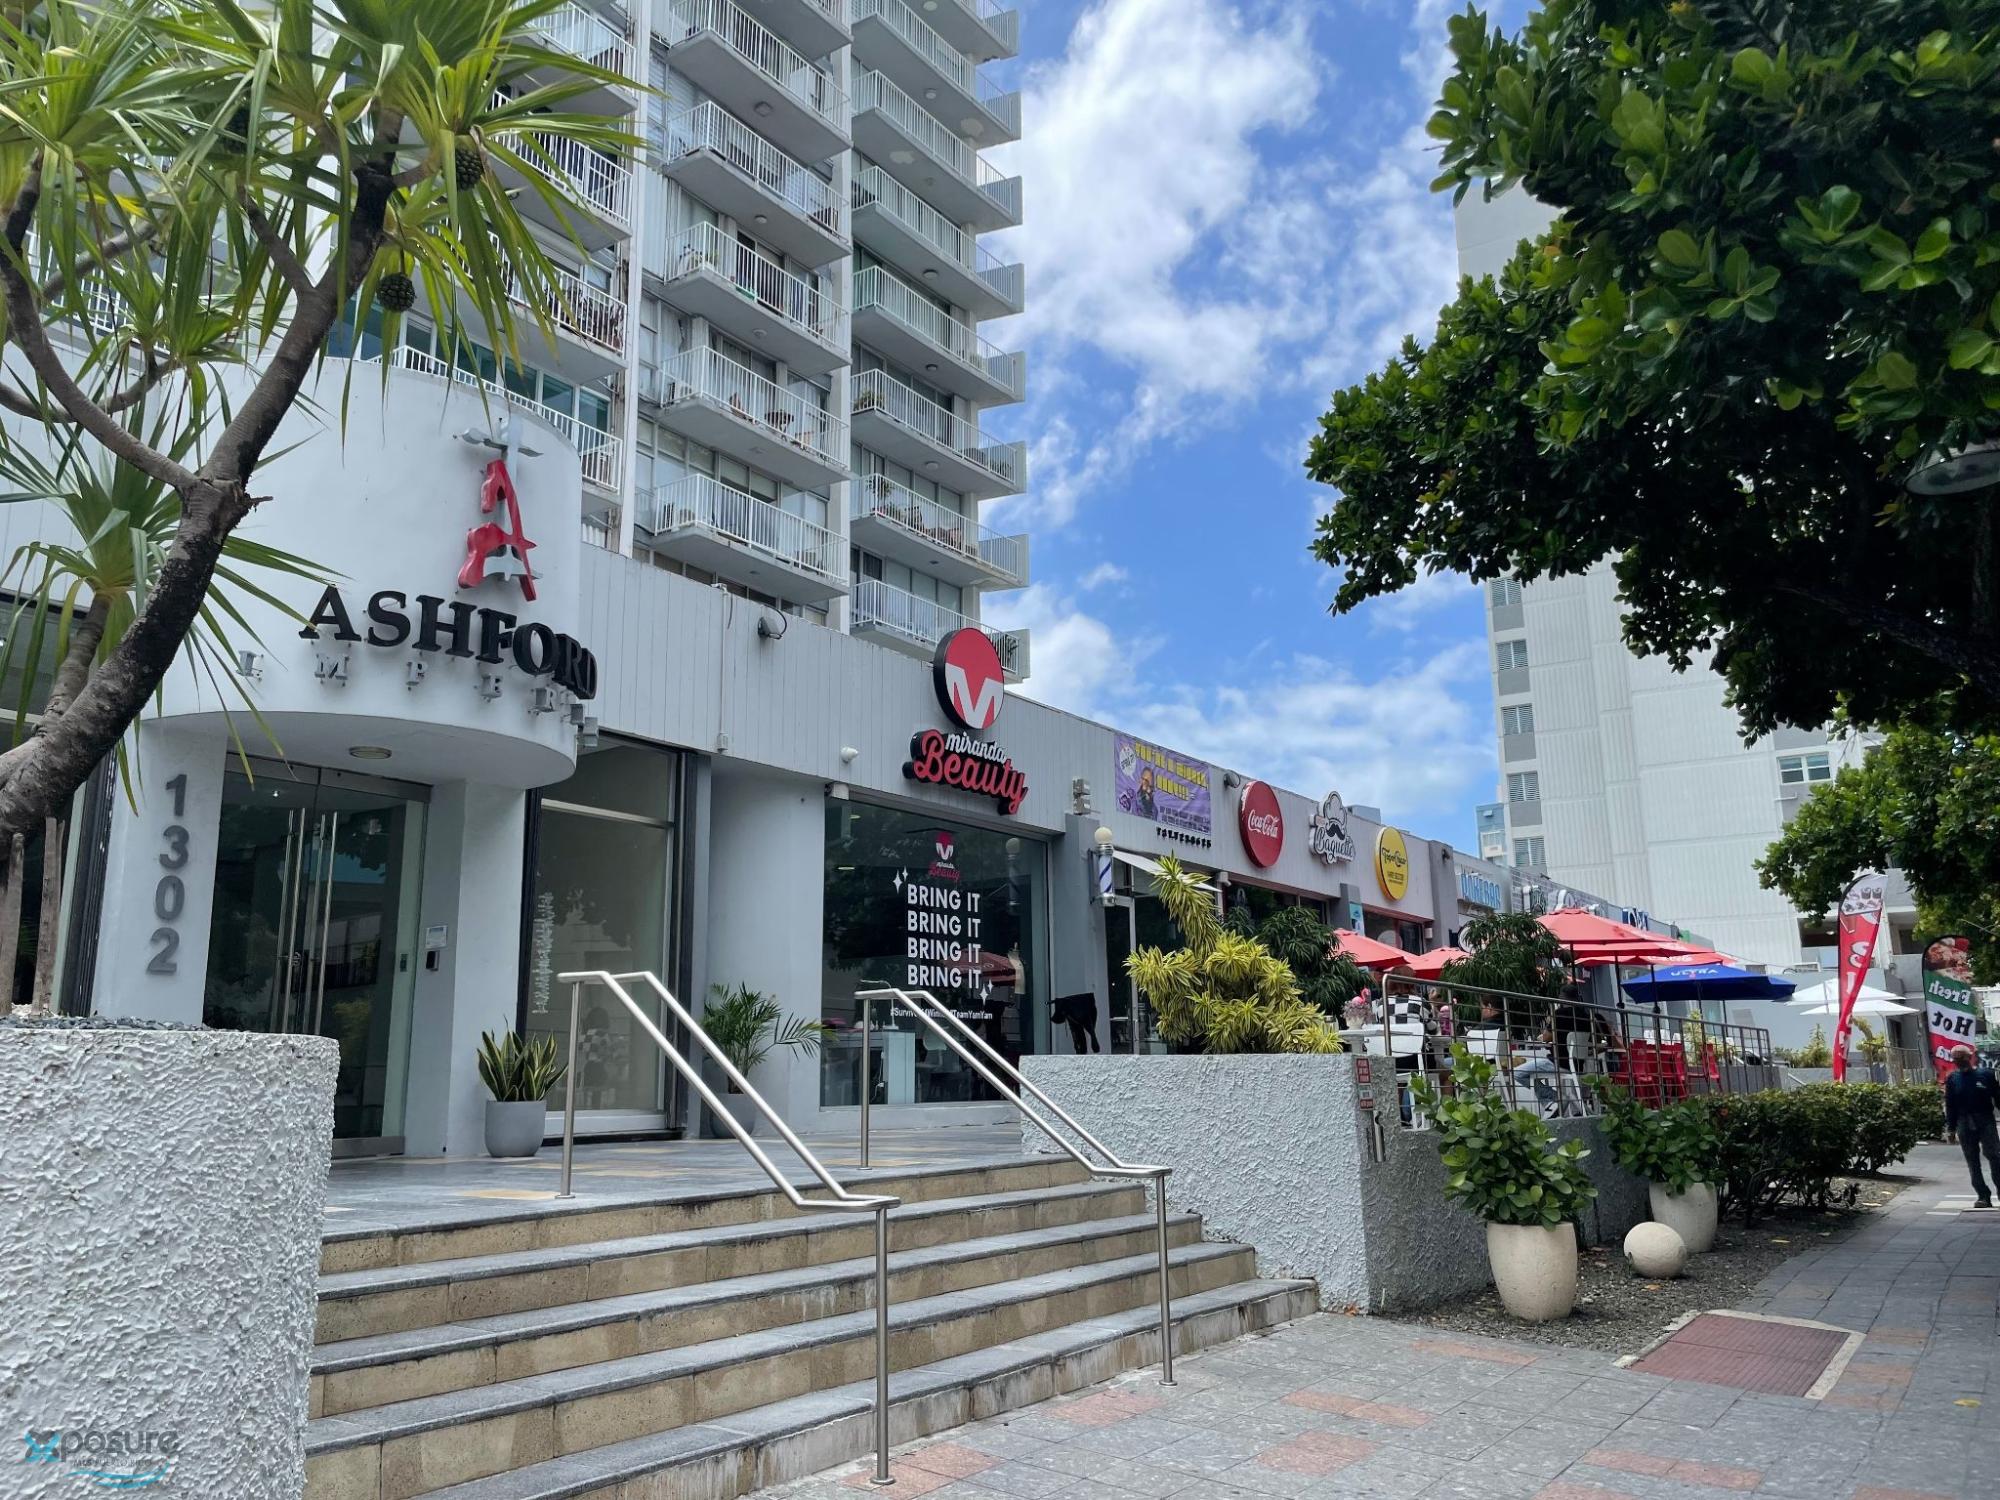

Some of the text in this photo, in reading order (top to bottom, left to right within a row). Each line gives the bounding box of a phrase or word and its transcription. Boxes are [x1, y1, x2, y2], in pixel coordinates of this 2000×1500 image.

[299, 583, 598, 700] ASHFORD
[944, 731, 1006, 764] miranda
[913, 728, 1028, 815] Beauty
[146, 772, 190, 976] 1302
[907, 884, 981, 913] BRING IT
[907, 910, 981, 938] BRING IT
[907, 936, 981, 964] BRING IT
[907, 964, 982, 989] BRING IT
